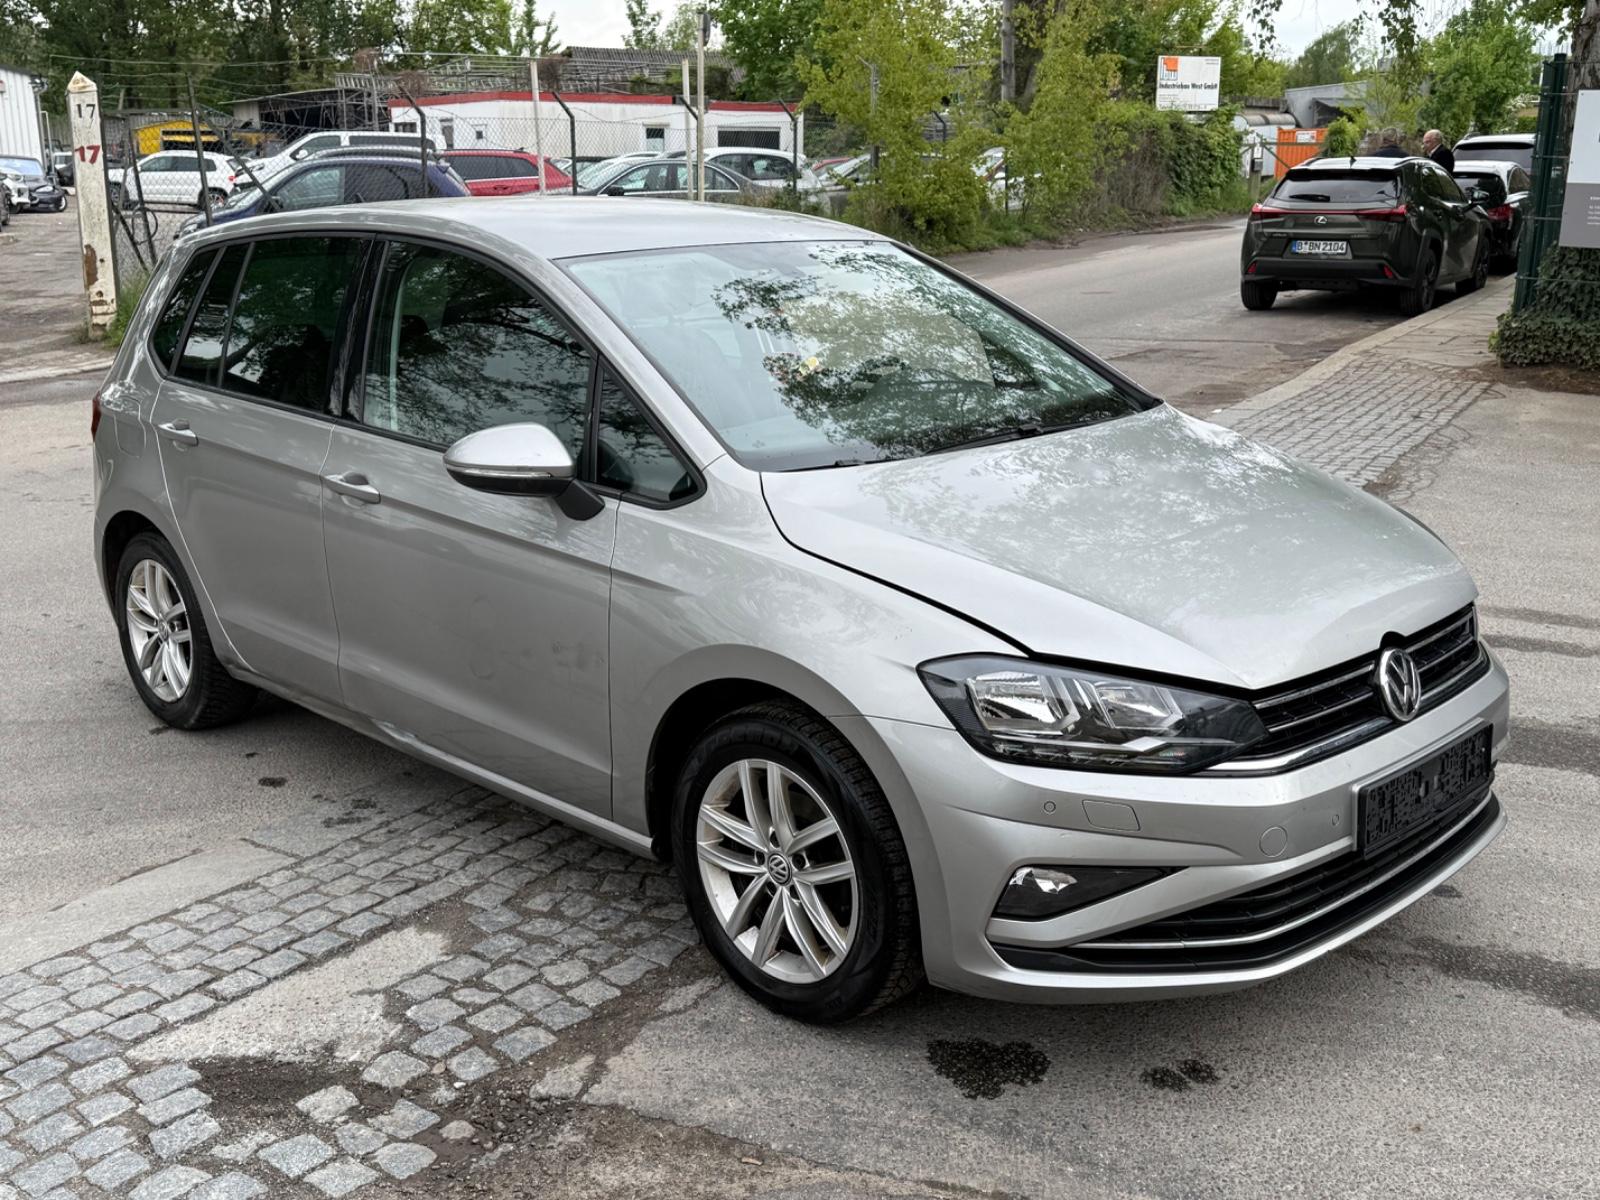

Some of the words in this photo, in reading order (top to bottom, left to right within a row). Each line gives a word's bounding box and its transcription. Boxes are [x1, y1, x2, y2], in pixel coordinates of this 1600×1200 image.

[76, 104, 96, 119] 17
[75, 145, 100, 165] 17
[1322, 242, 1345, 252] 2104
